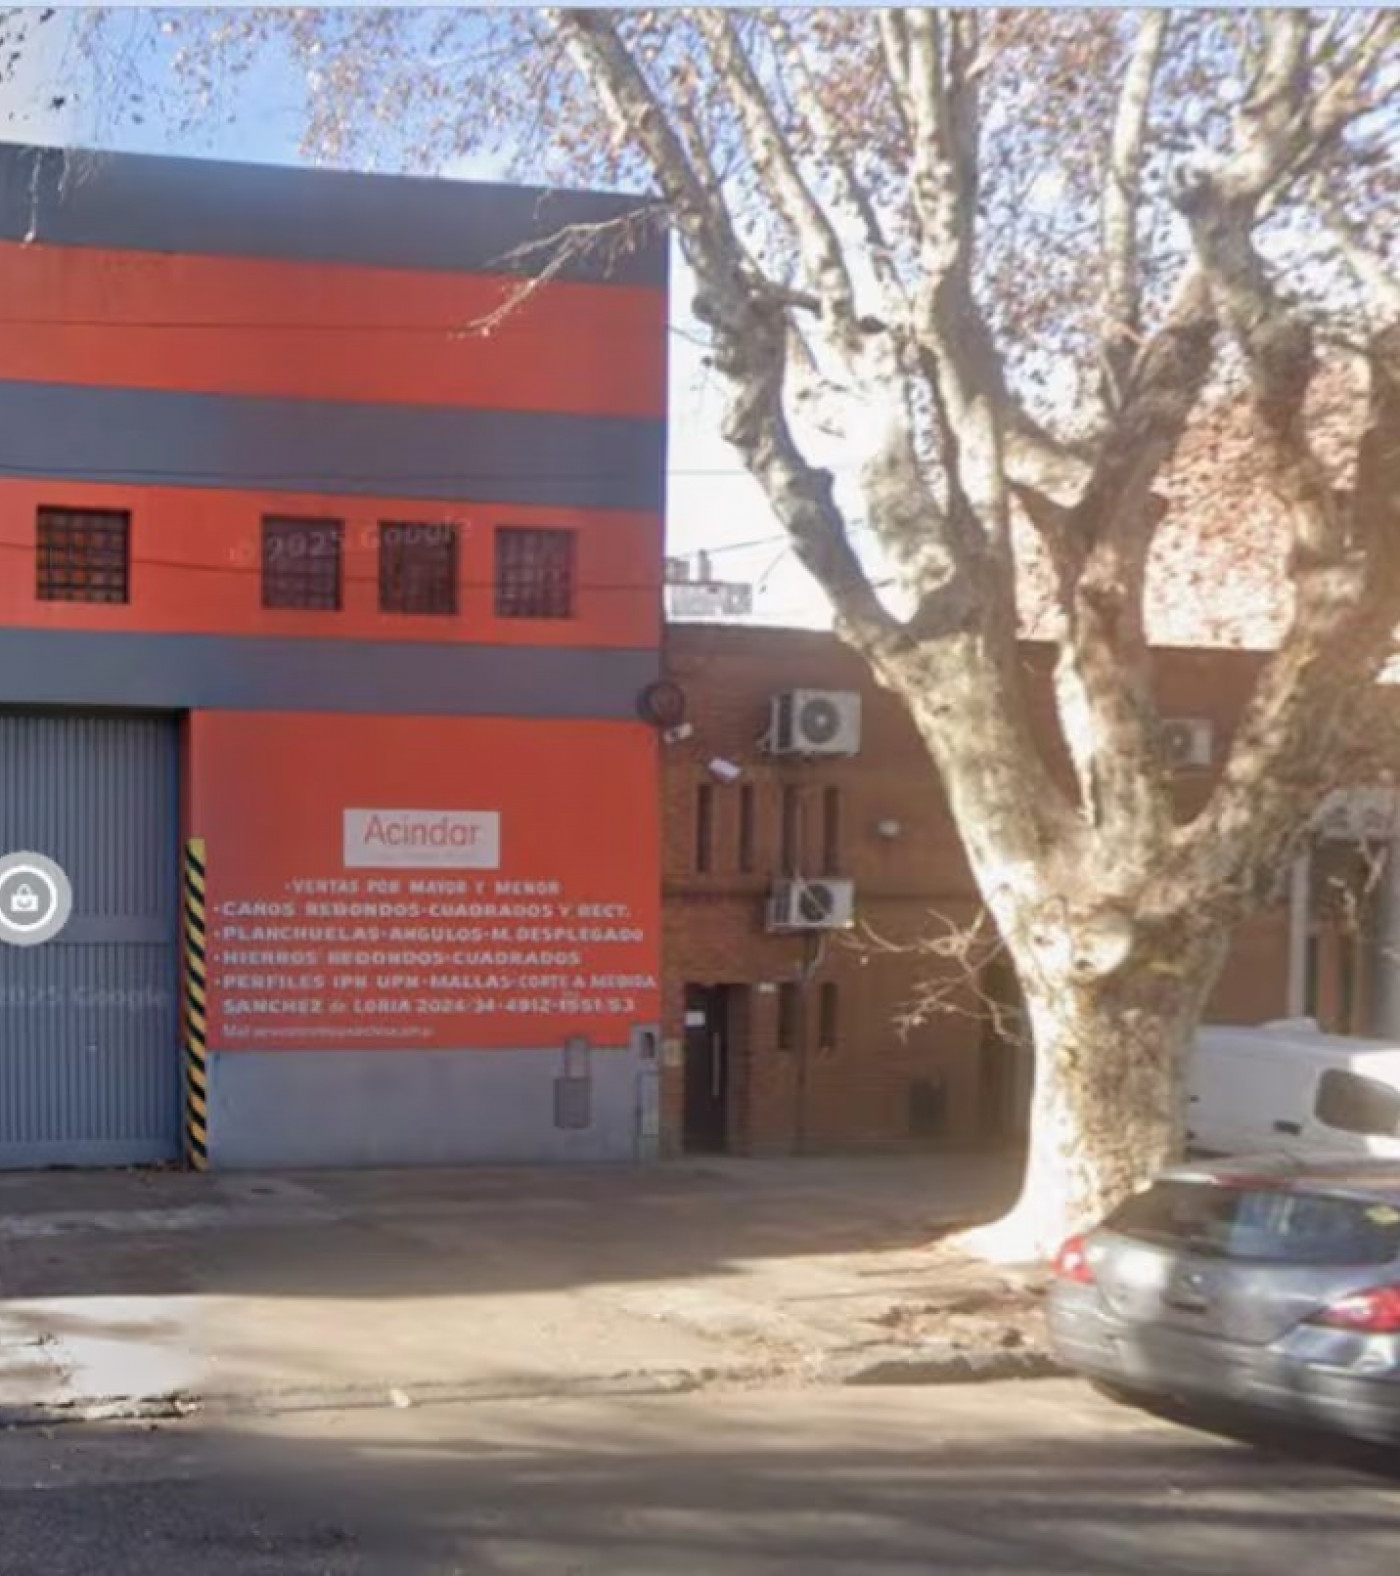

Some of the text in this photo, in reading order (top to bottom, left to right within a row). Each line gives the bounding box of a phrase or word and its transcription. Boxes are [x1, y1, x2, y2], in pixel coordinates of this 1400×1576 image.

[364, 813, 481, 846] Acindar
[292, 879, 560, 895] VENTAS POR MAYOR Y MENOR
[558, 904, 570, 917] Y
[222, 951, 318, 965] HIERROS
[222, 974, 325, 989] PERFILES
[572, 975, 585, 989] A
[222, 999, 323, 1014] SANCHEZ
[352, 999, 410, 1014] LORIA
